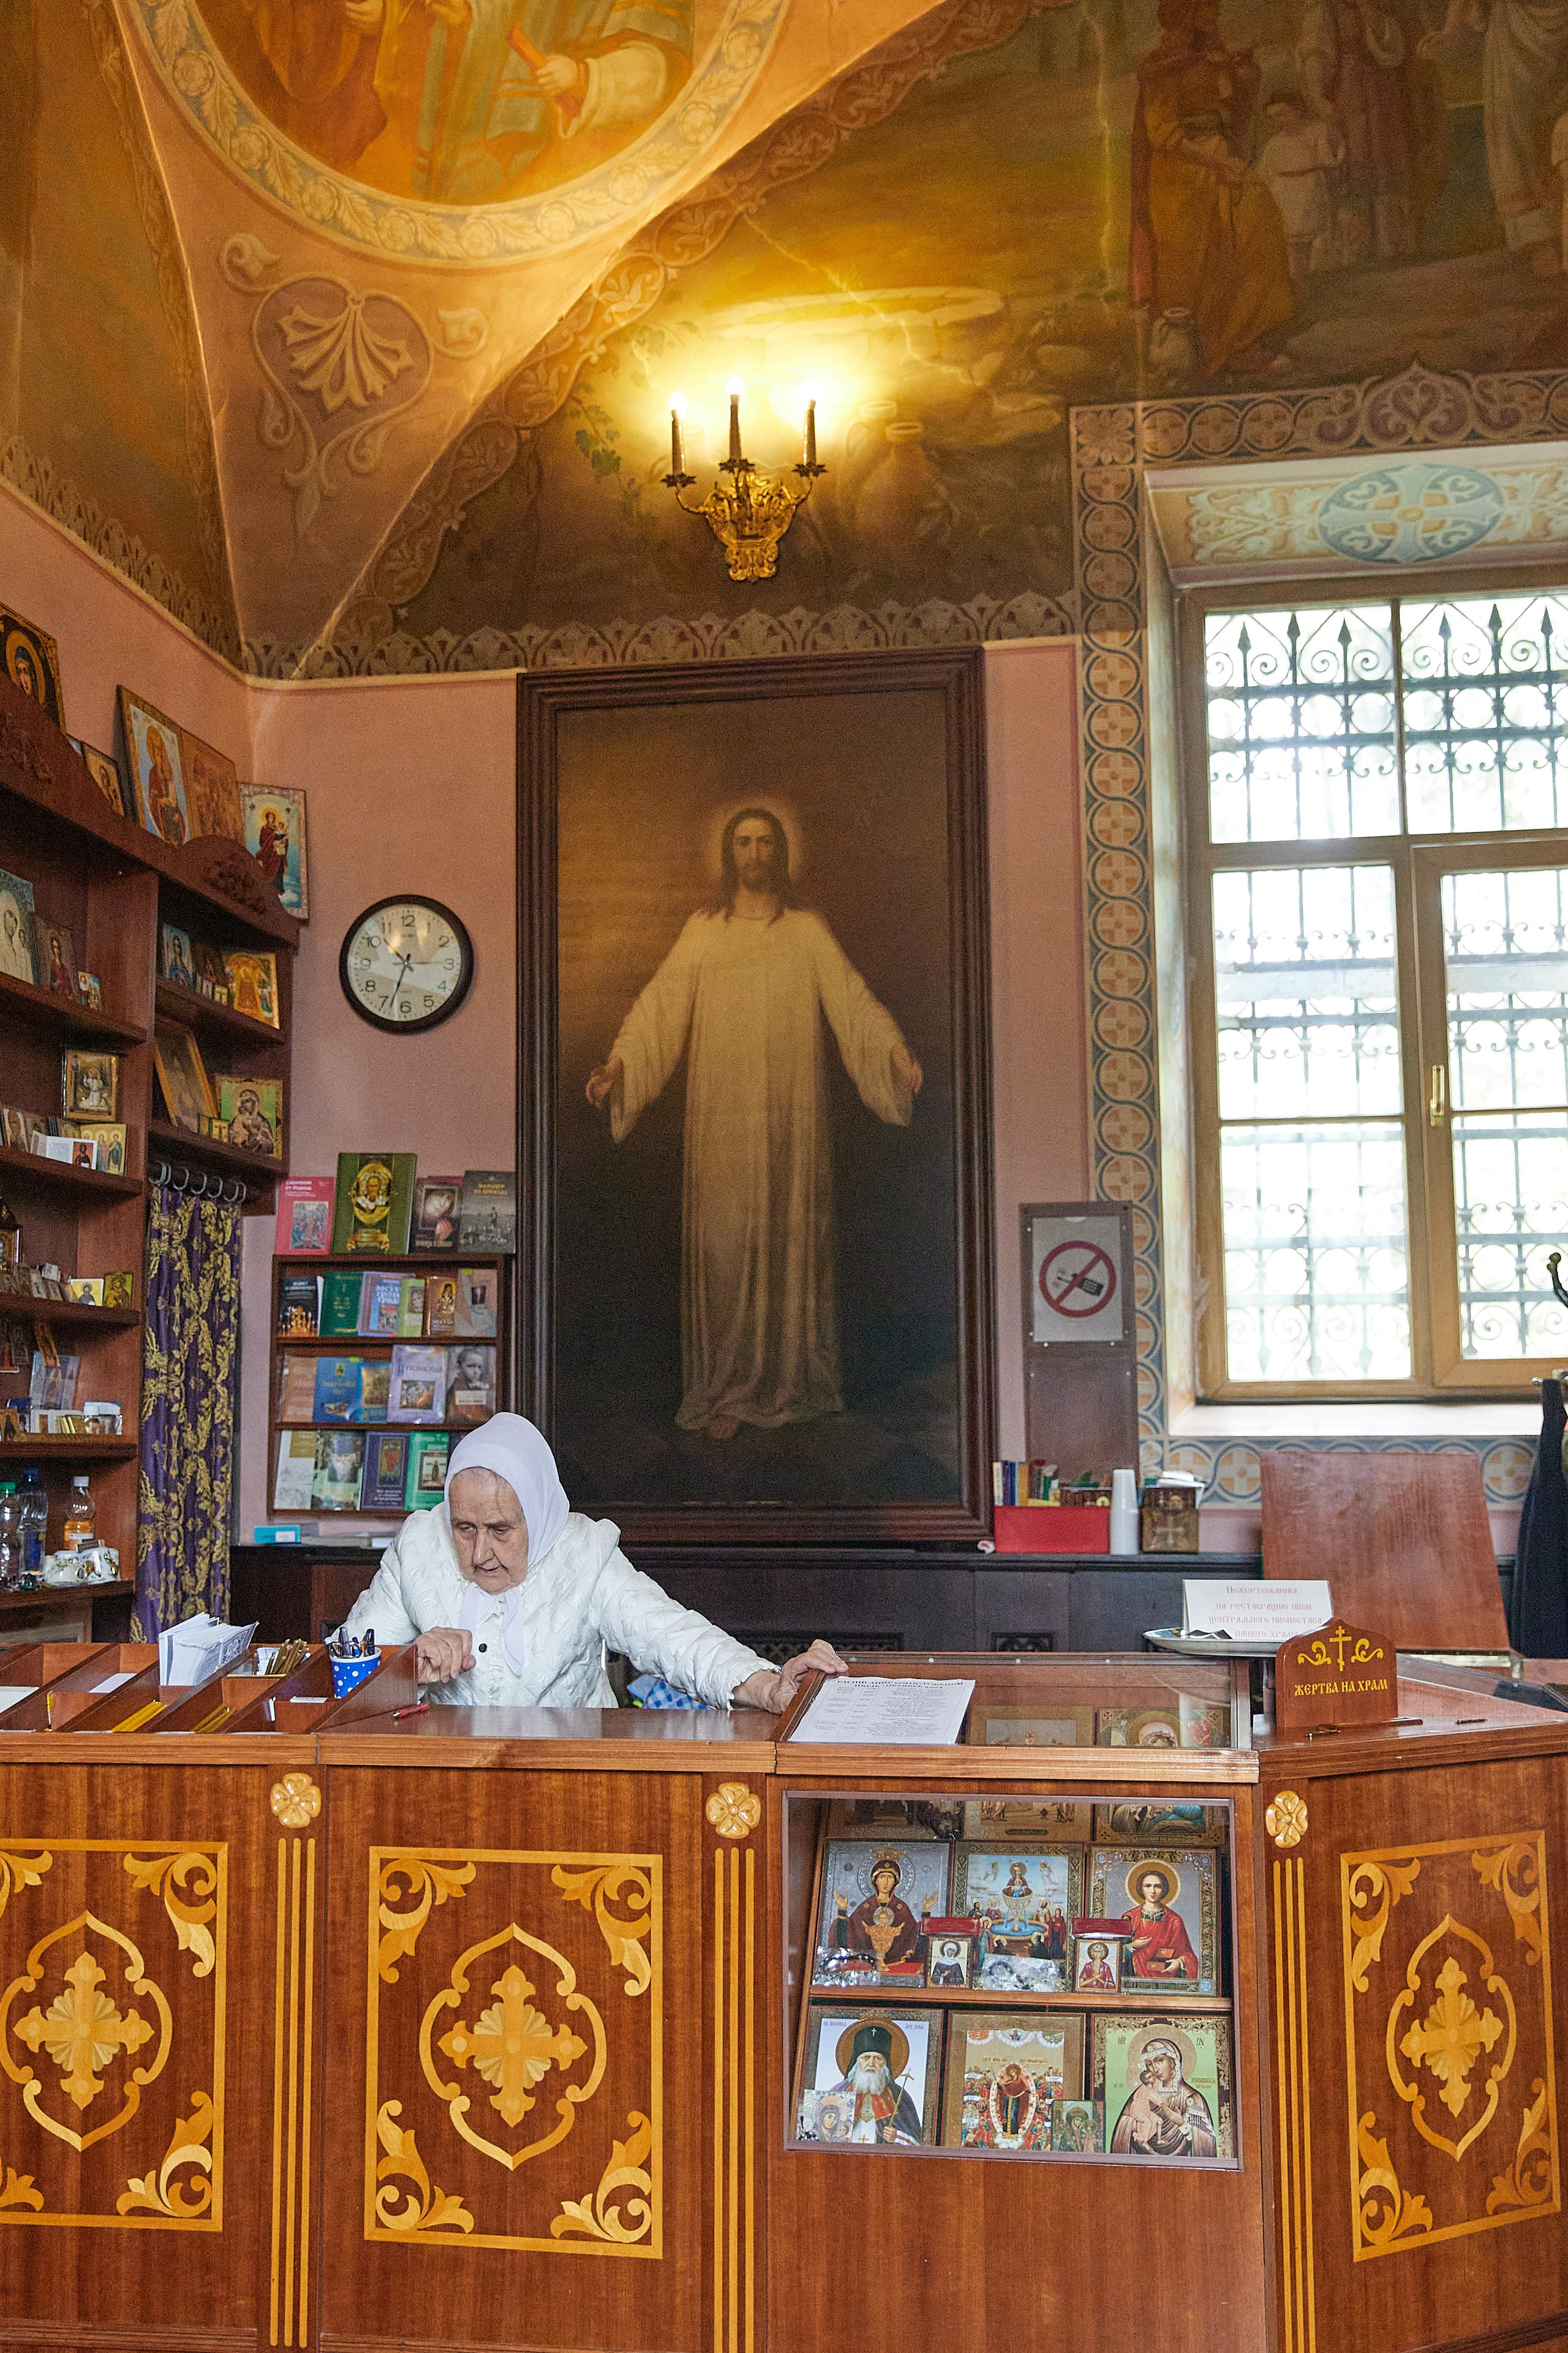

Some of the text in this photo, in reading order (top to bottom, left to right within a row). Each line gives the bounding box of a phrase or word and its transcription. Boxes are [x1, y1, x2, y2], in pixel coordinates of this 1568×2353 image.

[382, 921, 391, 933] 11
[401, 915, 416, 927] 12
[367, 936, 381, 948] 10
[438, 935, 450, 948] 2
[360, 957, 371, 970] 9
[443, 958, 454, 970] 3
[364, 980, 376, 992] 8
[437, 980, 447, 992] 4
[379, 995, 389, 1009] 7
[400, 1001, 412, 1013] 6
[423, 995, 434, 1008] 5
[1294, 1679, 1388, 1696] ЖЕРТВА НА ХРАМ
